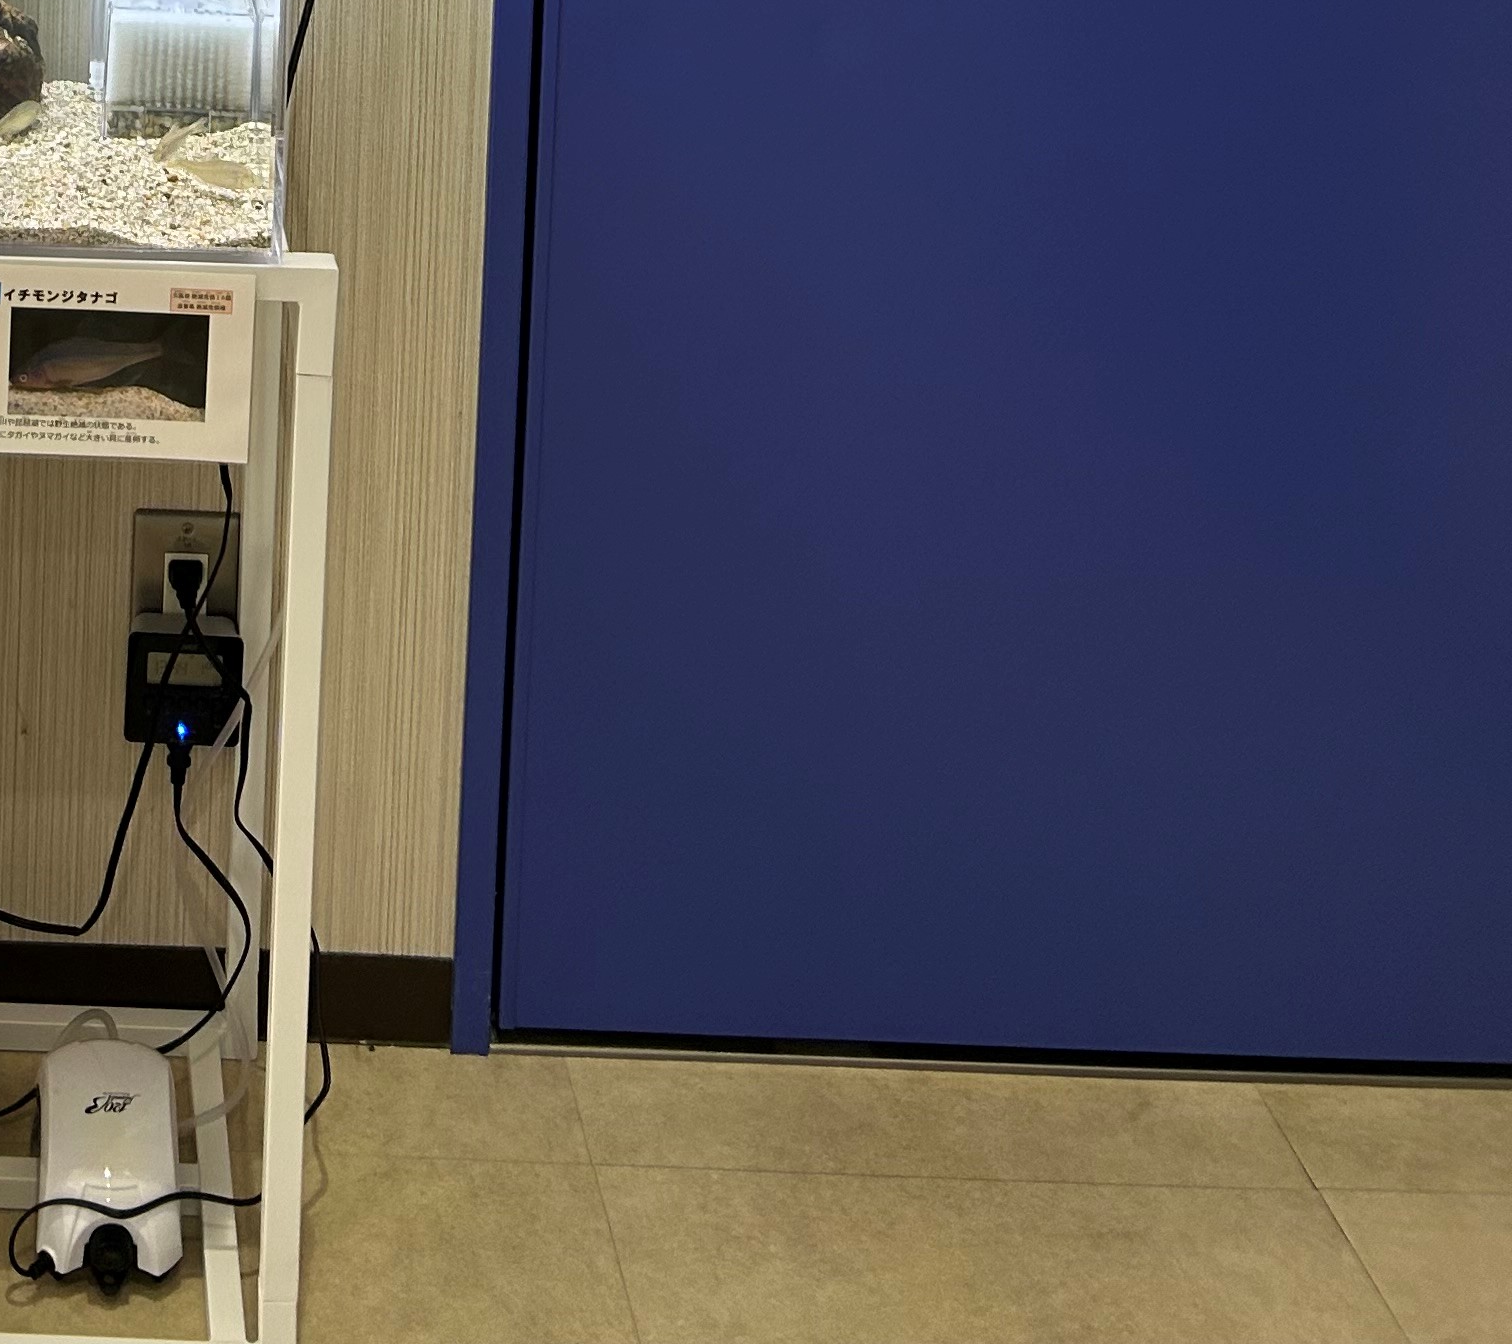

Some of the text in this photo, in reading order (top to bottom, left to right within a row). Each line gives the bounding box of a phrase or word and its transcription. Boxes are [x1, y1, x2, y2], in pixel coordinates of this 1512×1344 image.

[3, 288, 118, 304] イチモンジタナゴ
